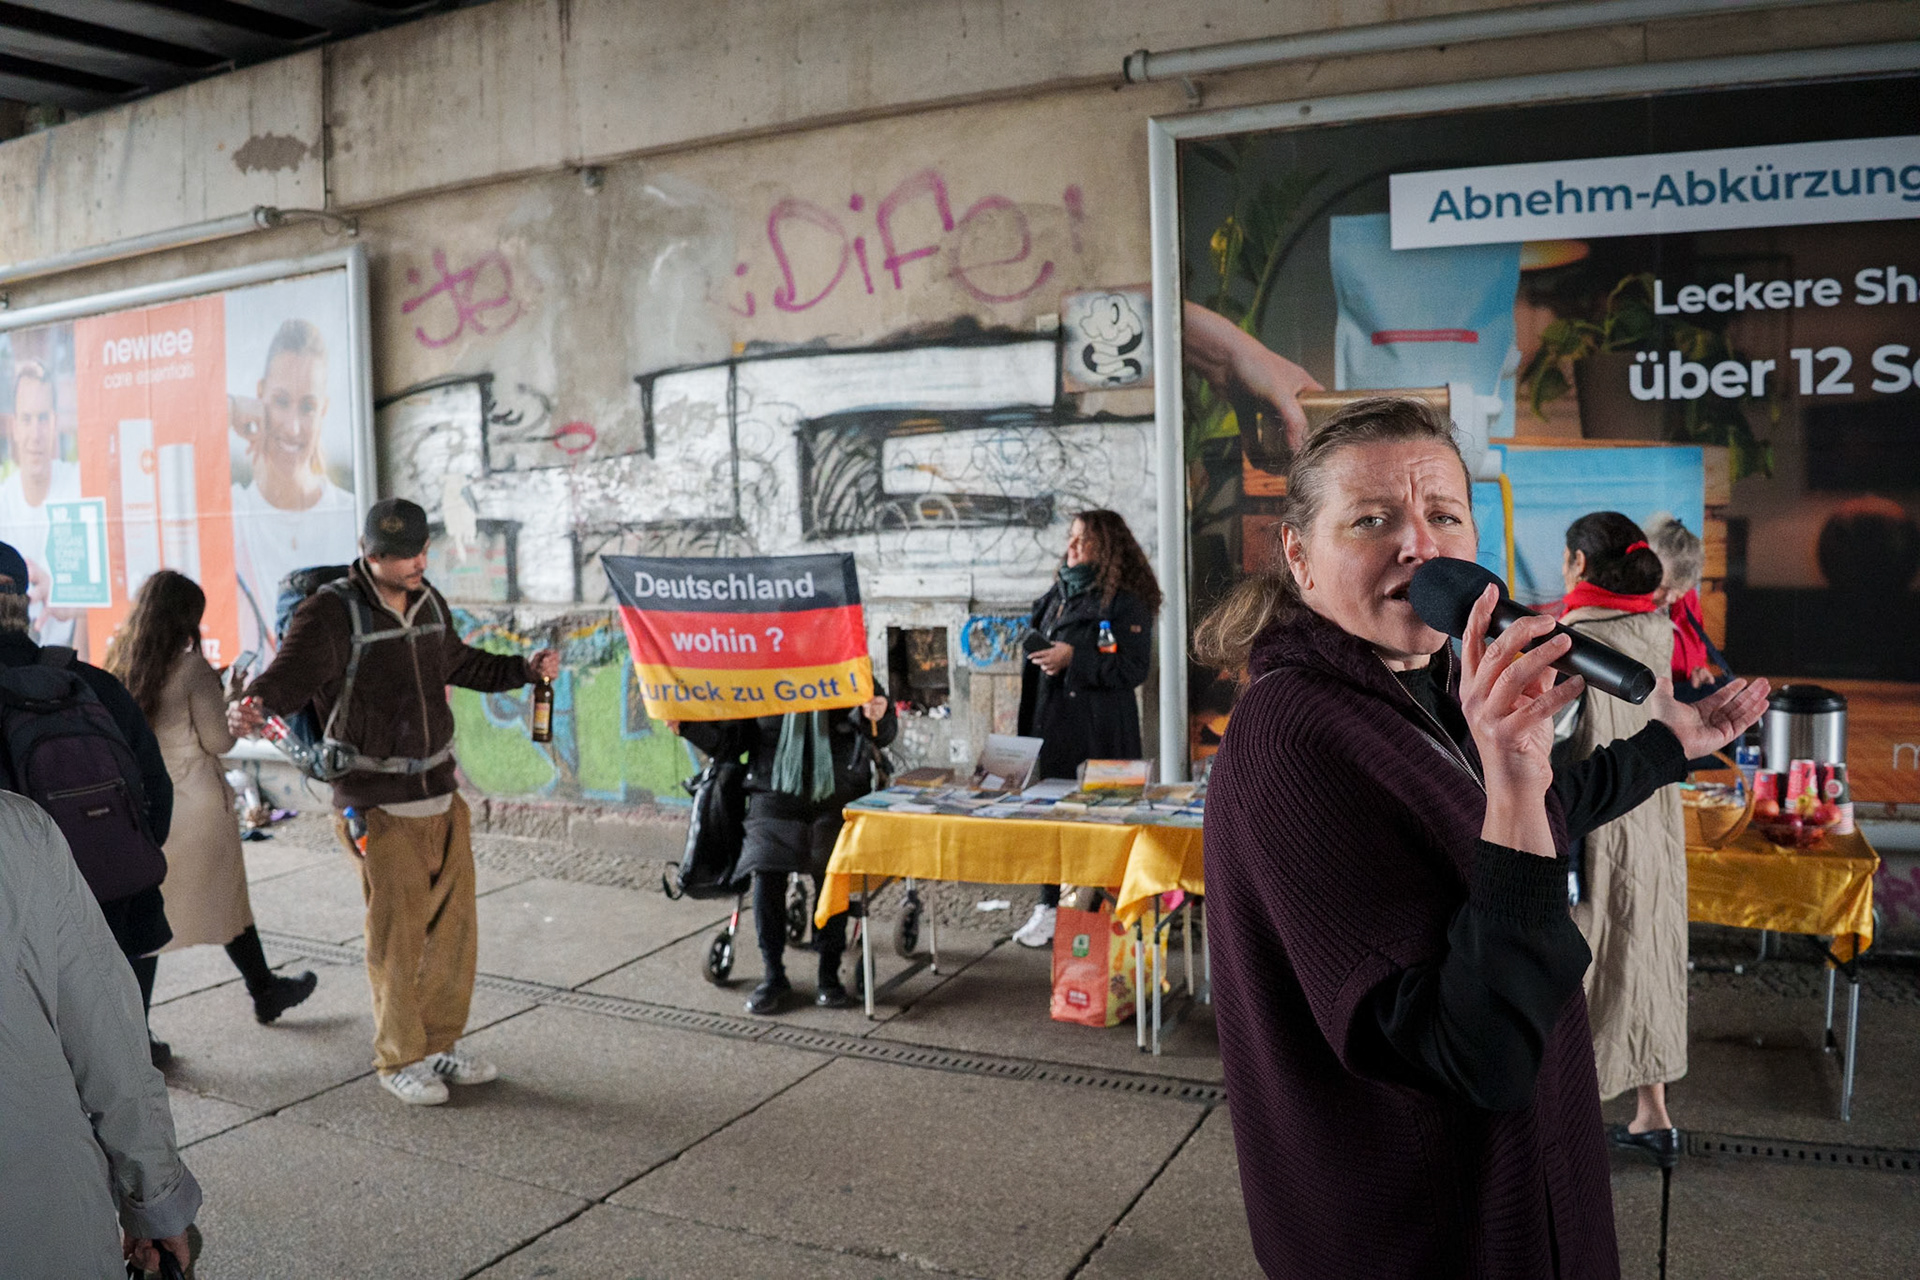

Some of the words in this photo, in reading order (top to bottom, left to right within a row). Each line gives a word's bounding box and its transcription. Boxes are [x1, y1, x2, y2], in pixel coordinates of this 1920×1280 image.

[1654, 273, 1843, 314] Leckere
[1855, 265, 1920, 305] Sh
[103, 327, 193, 365] newkee
[1629, 350, 1776, 400] über
[1790, 346, 1855, 395] 12
[1871, 344, 1920, 393] S
[634, 571, 815, 600] Deutschland
[670, 627, 757, 653] wohin
[765, 627, 784, 652] ?
[731, 686, 764, 702] zu
[774, 676, 842, 701] Gott
[849, 672, 859, 693] !
